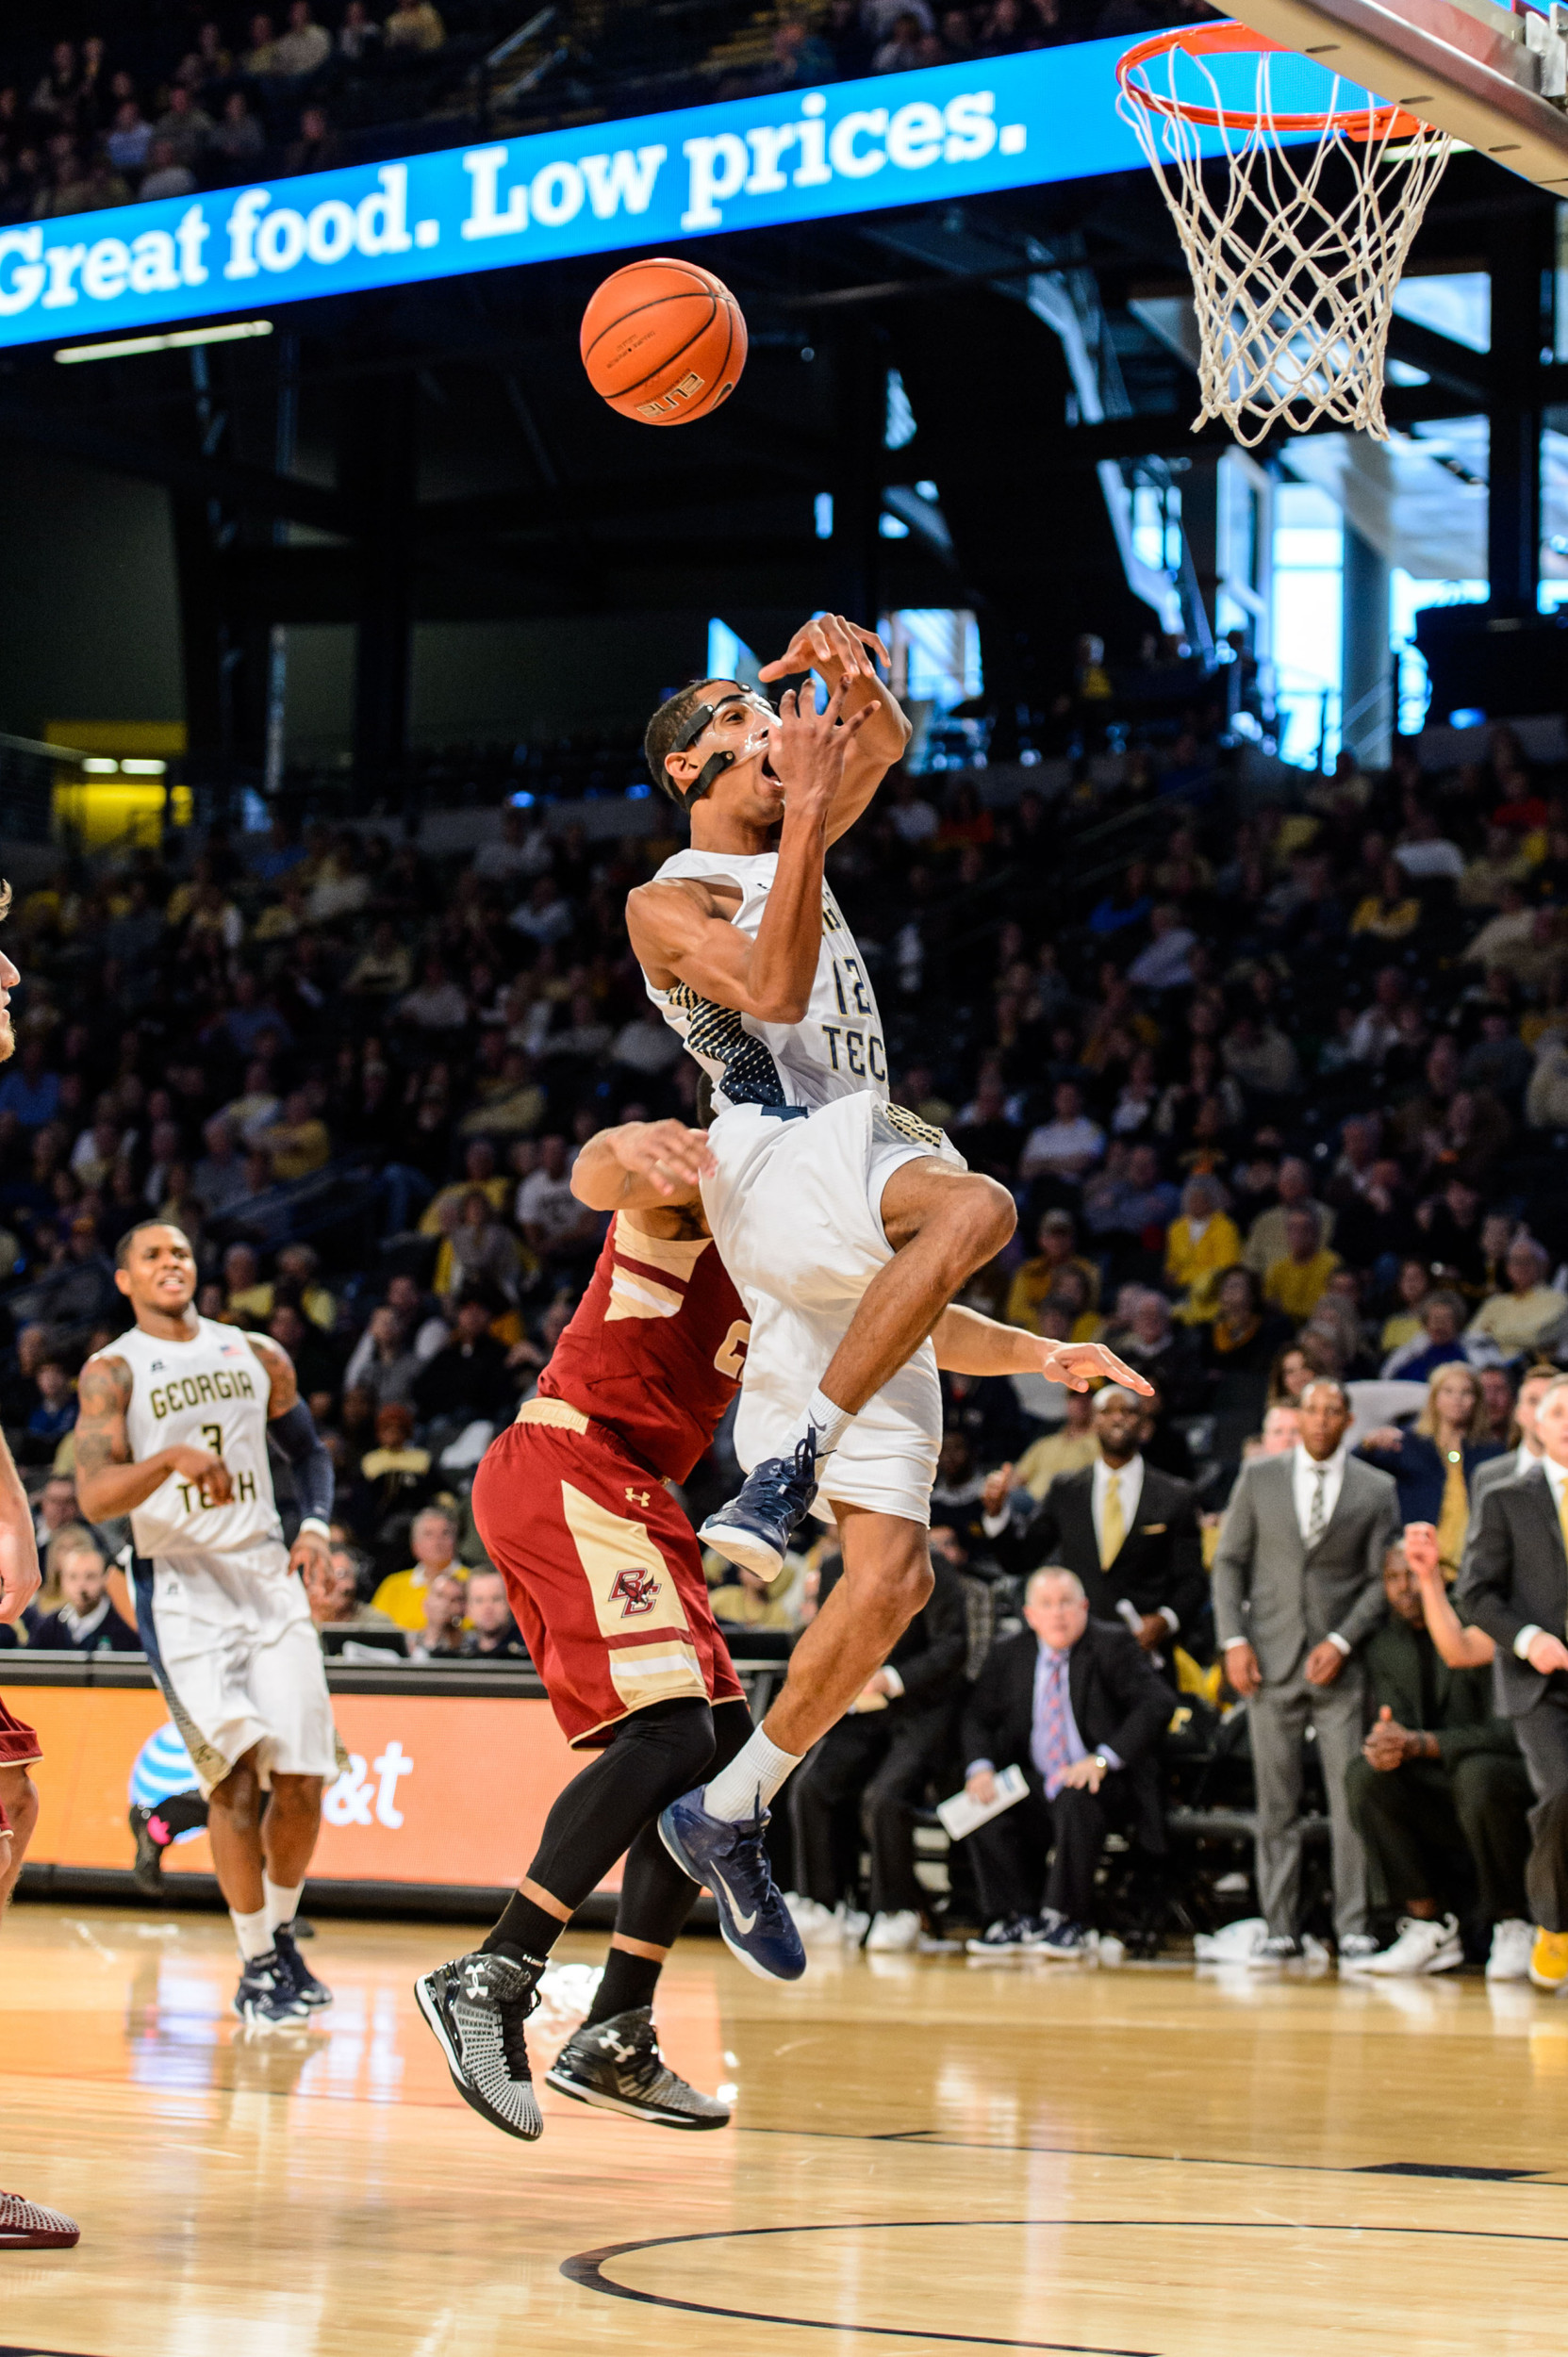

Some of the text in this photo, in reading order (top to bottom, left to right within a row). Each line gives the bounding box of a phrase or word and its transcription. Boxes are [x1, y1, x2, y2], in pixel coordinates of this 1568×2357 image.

[0, 91, 1028, 317] Great food. Low prices.
[832, 956, 875, 1019] 12
[150, 1369, 256, 1421] GEORGIA
[201, 1423, 223, 1458] 3
[175, 1470, 257, 1513] TEH
[608, 1568, 662, 1618] BC
